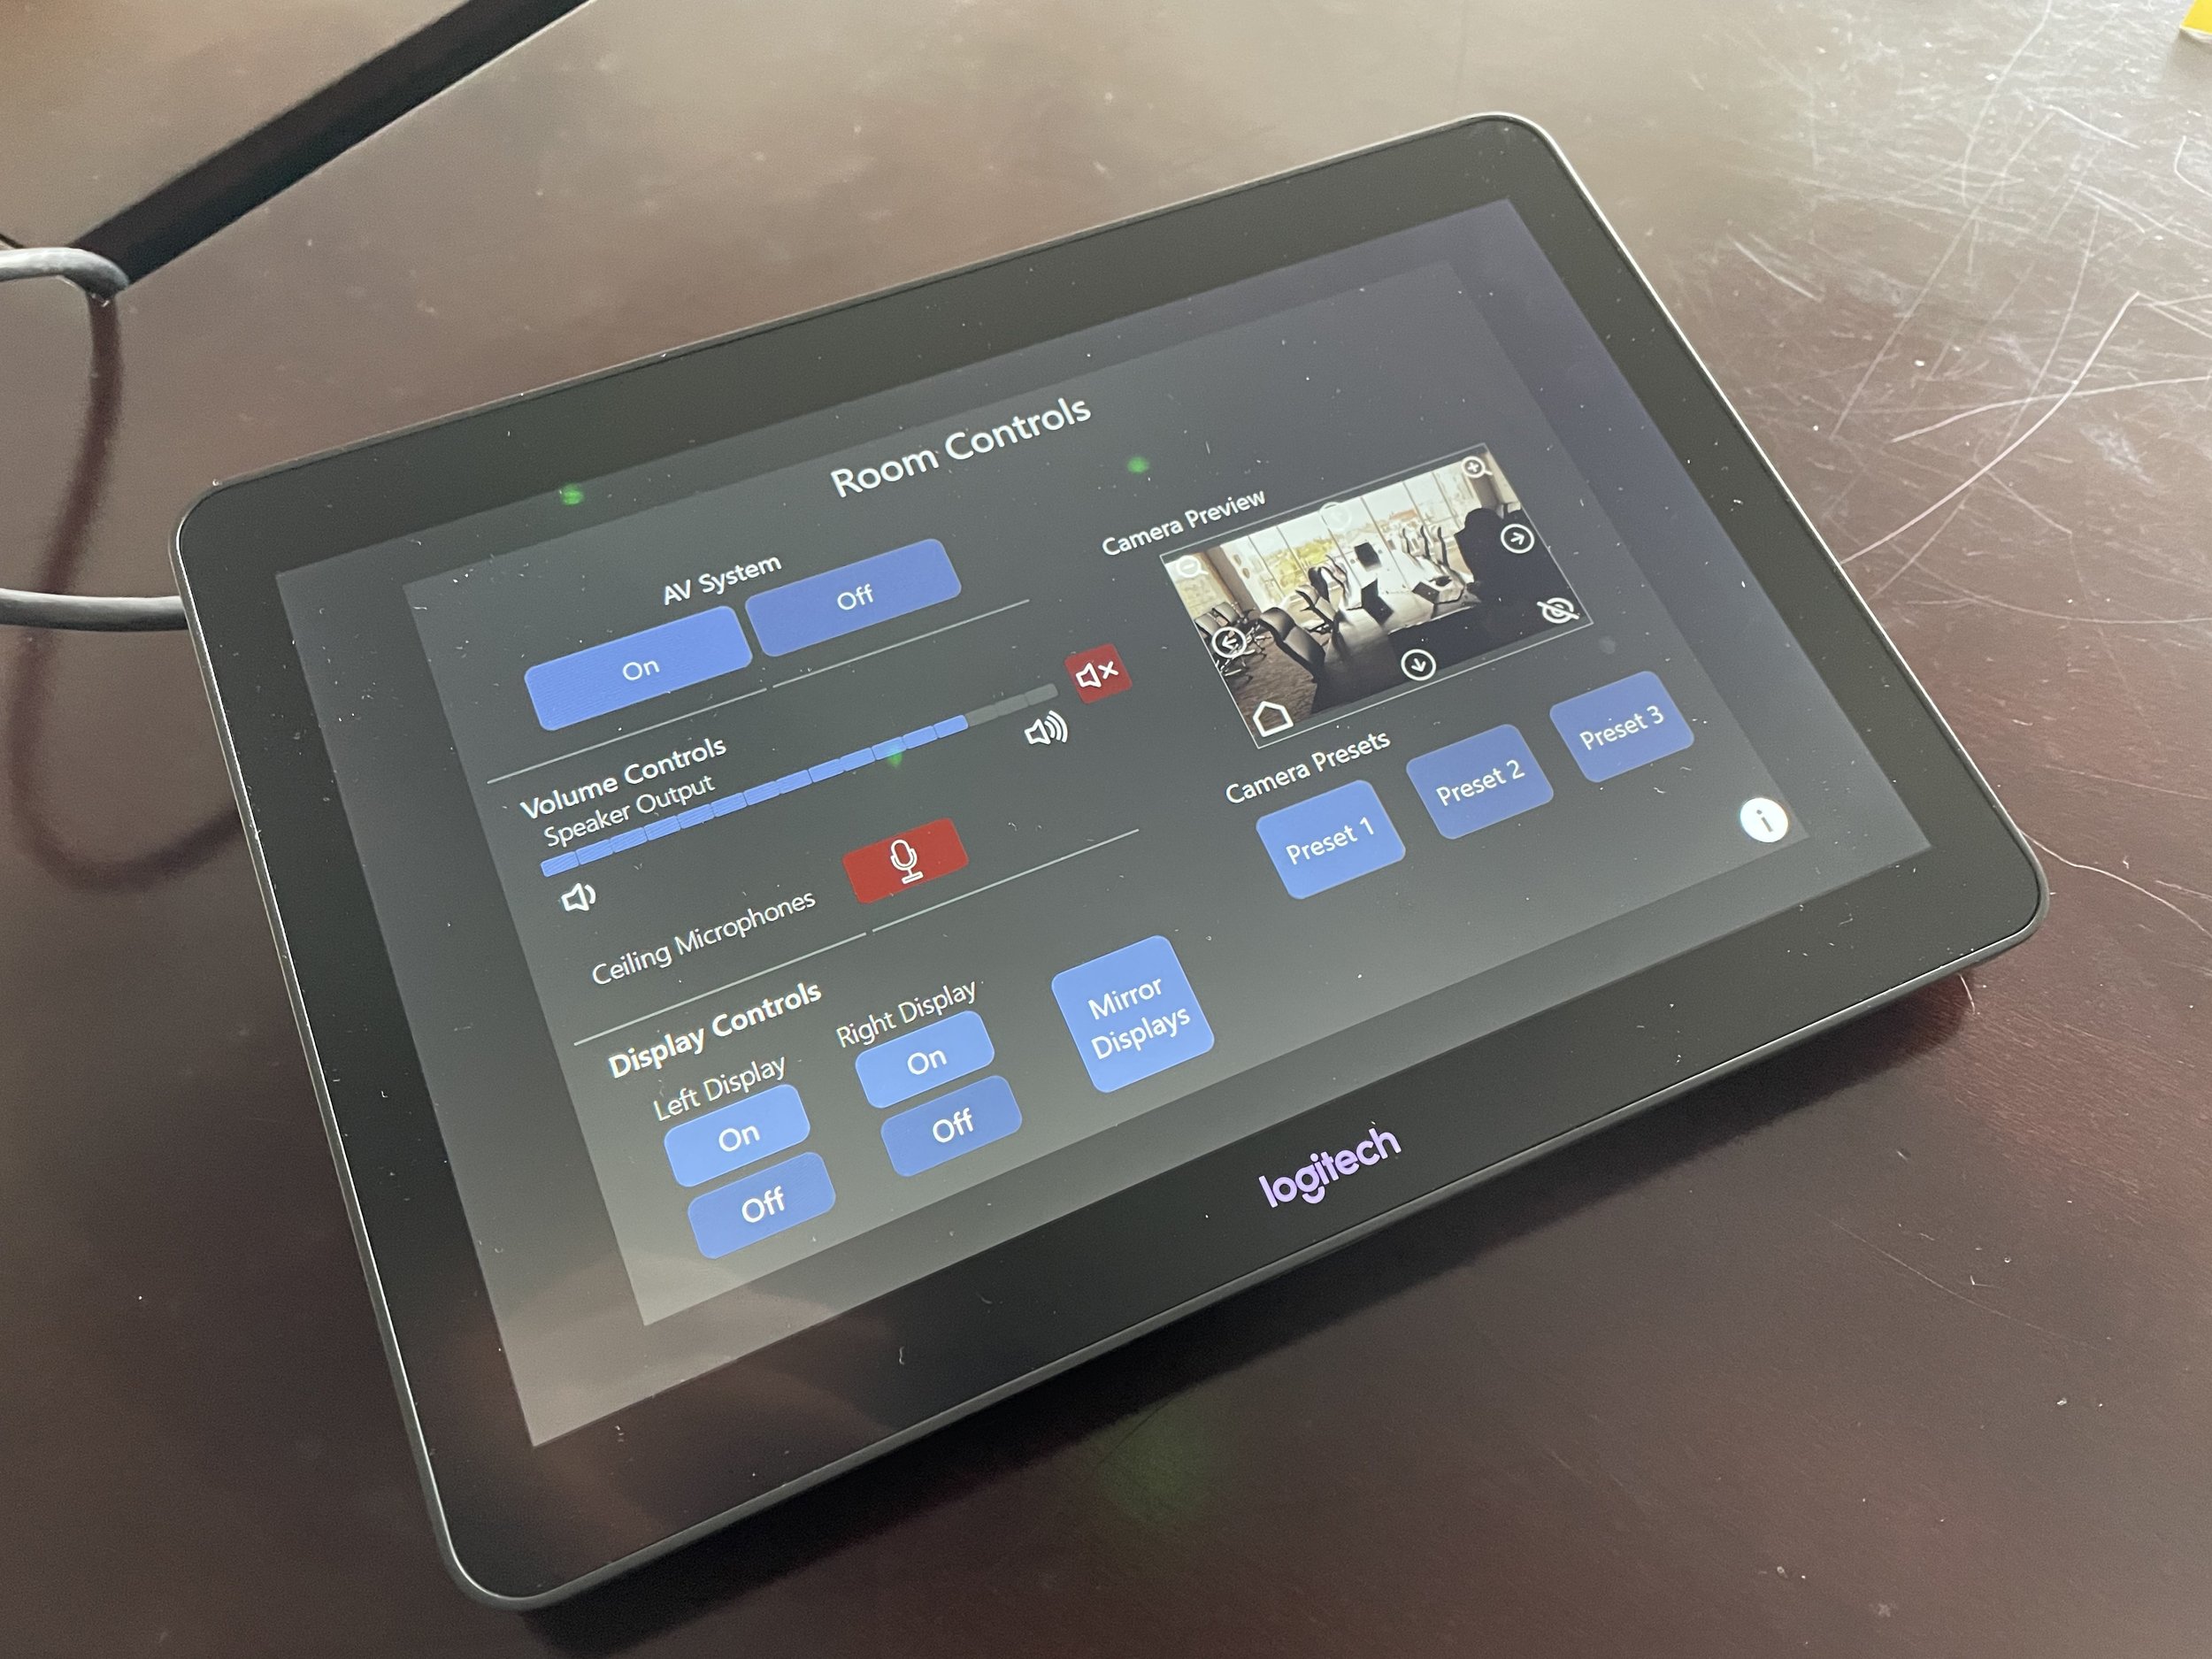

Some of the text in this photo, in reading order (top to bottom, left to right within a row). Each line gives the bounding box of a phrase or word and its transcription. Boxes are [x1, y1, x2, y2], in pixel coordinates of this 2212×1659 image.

[831, 398, 1091, 497] Room Controls
[1102, 490, 1266, 556] Camera Preview
[663, 555, 783, 605] AV System
[837, 583, 875, 611] Off
[623, 657, 659, 681] On
[1579, 705, 1665, 750] Preset 3
[520, 737, 727, 819] Volume Controls
[1225, 731, 1392, 804] Camera Presets
[1437, 759, 1526, 807] Preset 2
[543, 775, 716, 848] Speaker Output
[1286, 817, 1376, 865] Preset 1
[591, 892, 817, 985] Ceiling Microphones
[835, 980, 978, 1048] Right Display
[1087, 978, 1164, 1019] Mirror
[608, 983, 823, 1078] Display Controls
[1091, 1008, 1191, 1060] Displays
[907, 1048, 948, 1075] On
[654, 1056, 787, 1121] Left Display
[718, 1123, 760, 1151] On
[932, 1108, 974, 1143] Off
[1258, 1128, 1402, 1208] logitech
[741, 1186, 786, 1223] Off
